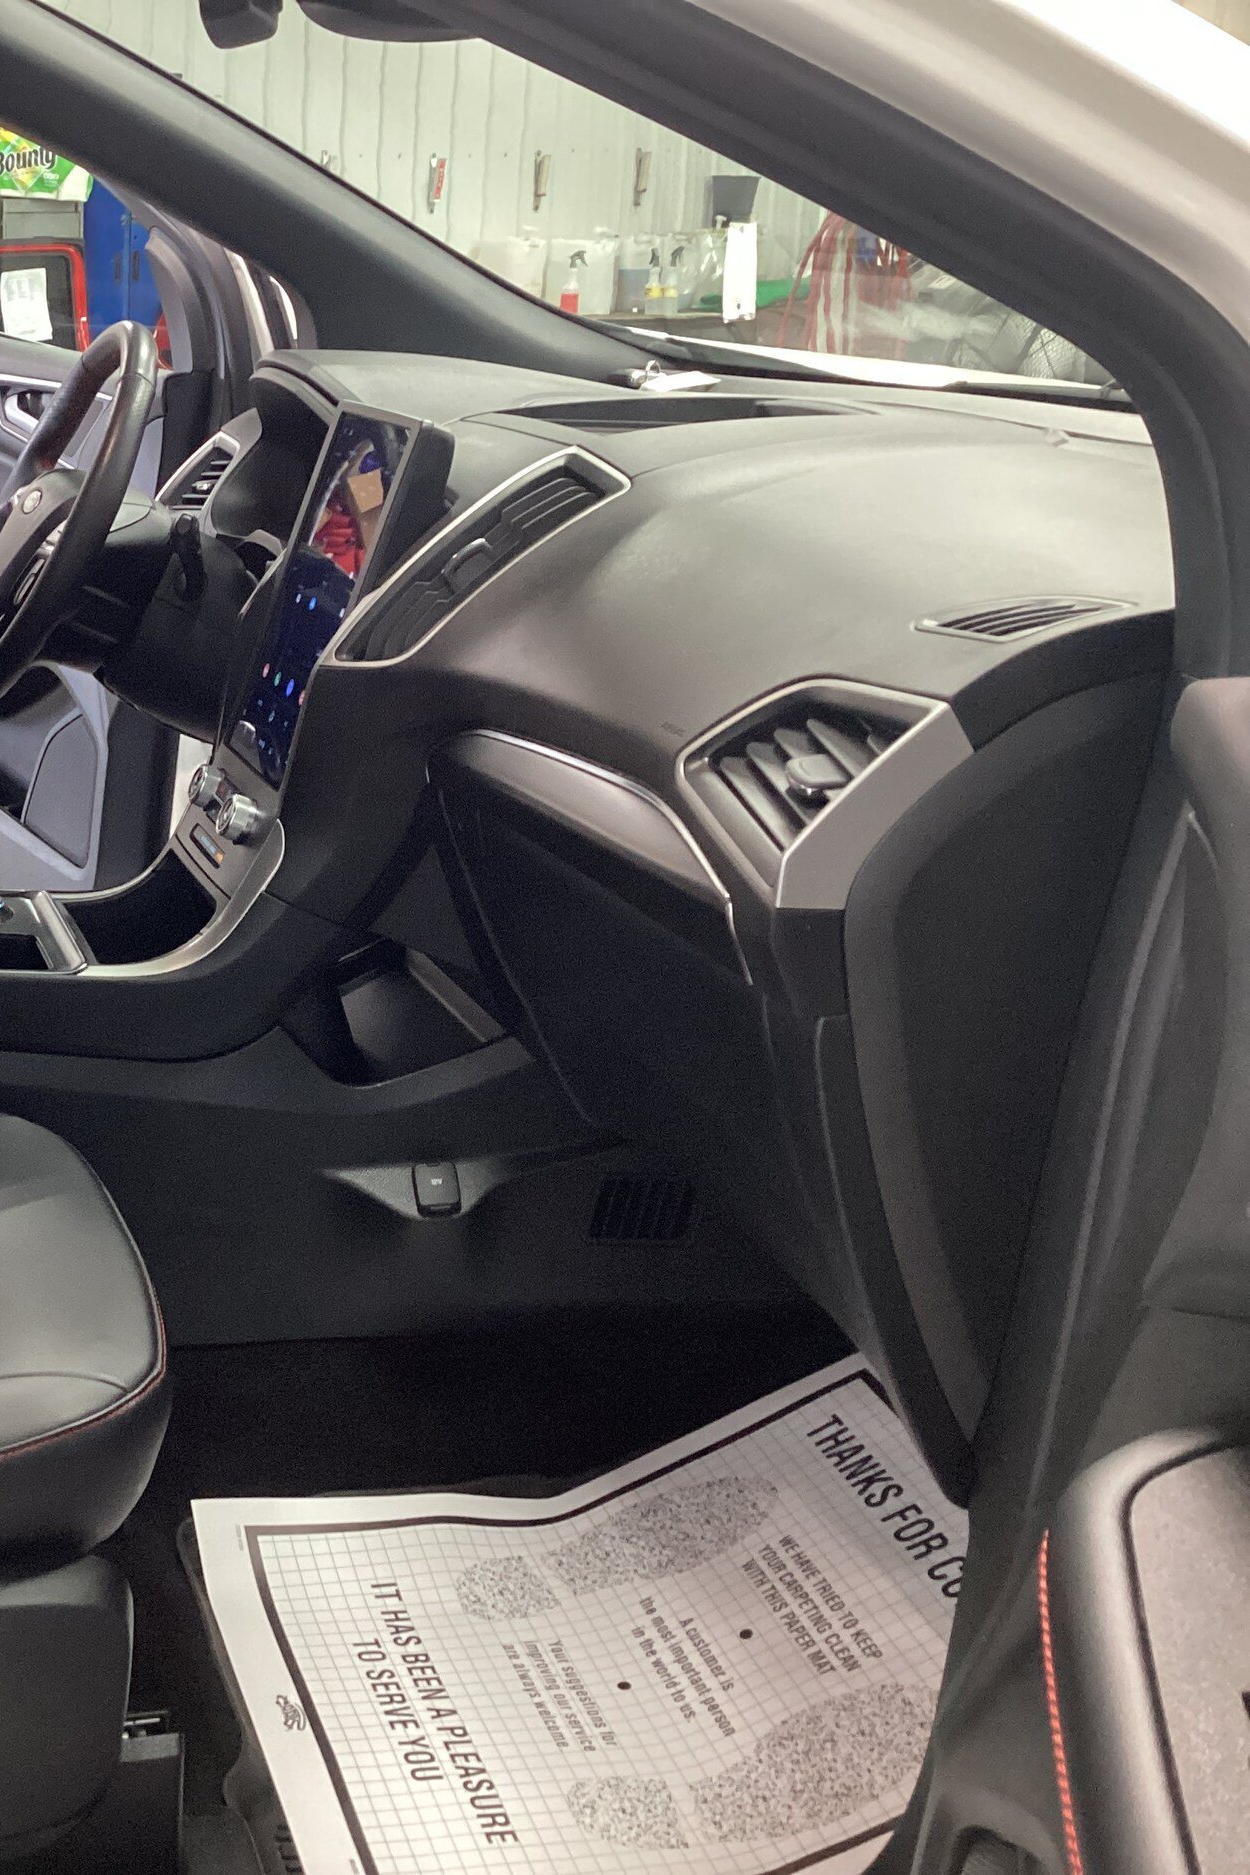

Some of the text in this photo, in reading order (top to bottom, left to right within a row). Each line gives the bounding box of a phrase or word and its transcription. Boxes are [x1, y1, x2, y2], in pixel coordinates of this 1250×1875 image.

[806, 1413, 904, 1508] THANKS
[880, 1503, 949, 1561] FOR
[679, 1617, 735, 1692] A customer is
[741, 1558, 837, 1676] WITH THIS PAPER MAT
[758, 1543, 862, 1672] YOUR CARPETING CLEAN
[778, 1534, 883, 1659] WE HAVE TRIED TO KEEP
[352, 1637, 445, 1783] TO SERVE YOU
[370, 1582, 519, 1845] IT HAS BEEN A PLEASURE
[502, 1643, 521, 1660] are
[512, 1663, 542, 1699] always
[548, 1639, 618, 1747] Your suggestions for
[553, 1693, 573, 1711] our
[564, 1713, 596, 1752] service
[631, 1625, 696, 1724] in the world to us.
[639, 1596, 736, 1738] the most important person
